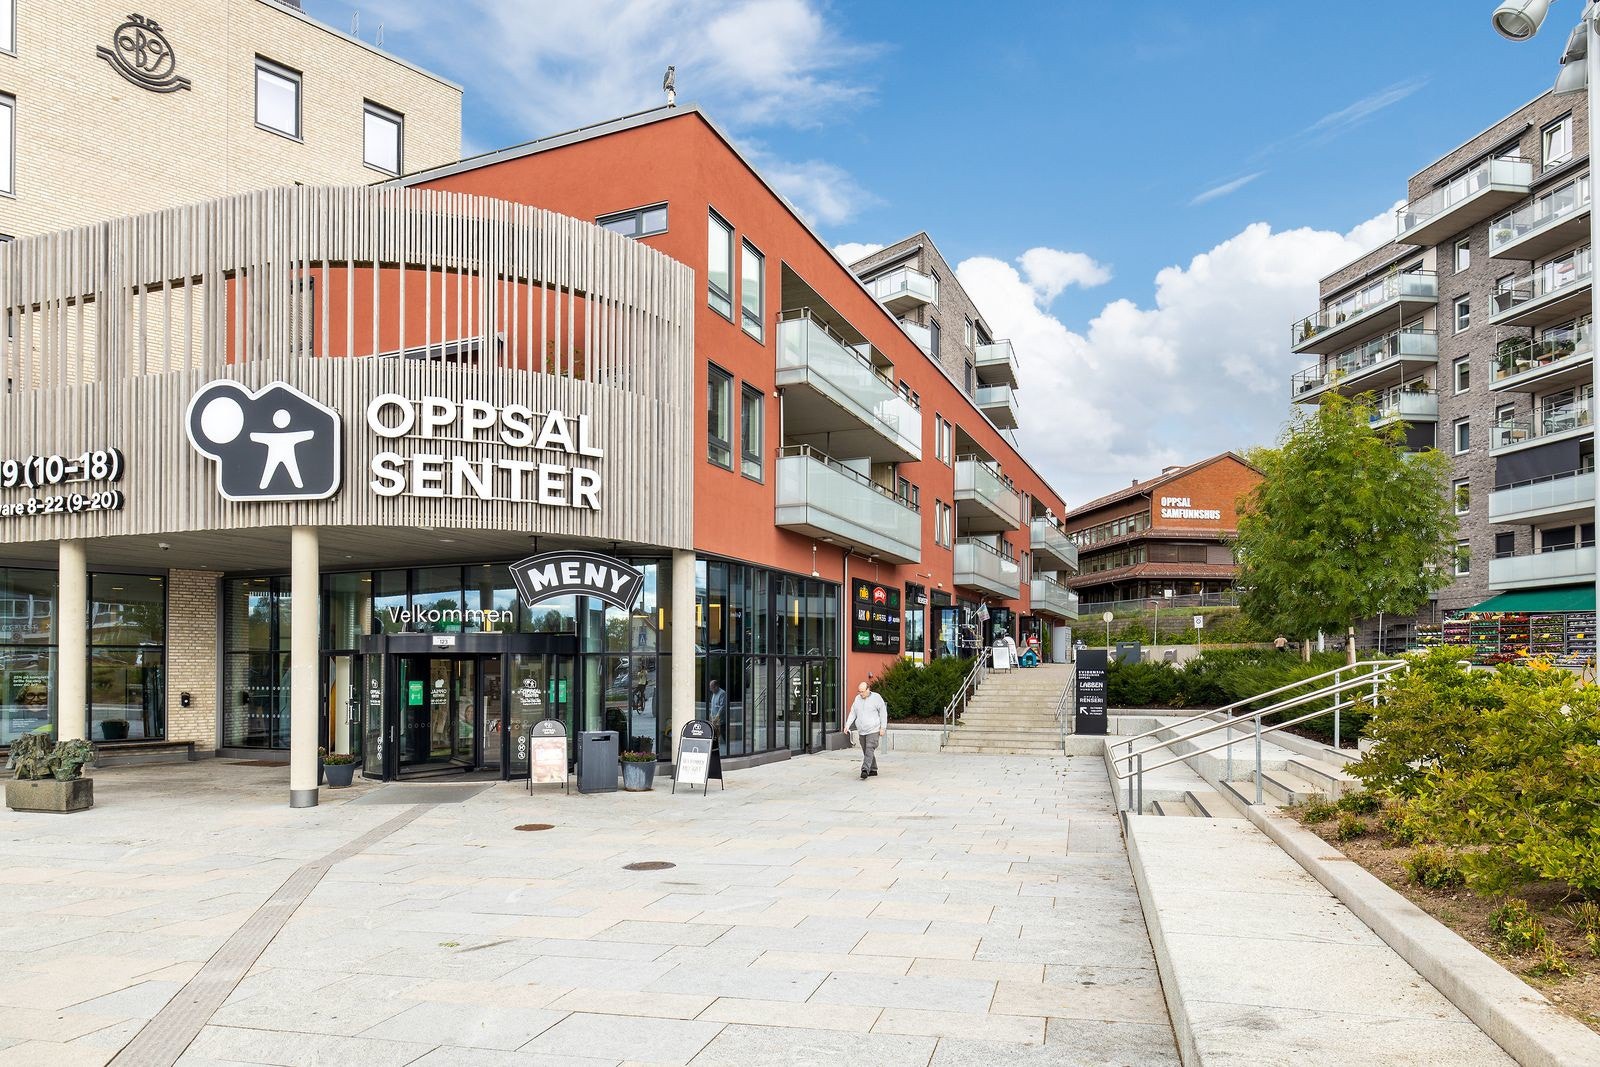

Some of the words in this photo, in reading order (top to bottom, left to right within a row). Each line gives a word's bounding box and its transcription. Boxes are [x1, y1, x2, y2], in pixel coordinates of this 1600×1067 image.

[367, 393, 604, 458] OPPSAL
[0, 459, 19, 488] 9
[370, 451, 602, 511] SENTER
[1161, 497, 1191, 508] OPPSAL
[1161, 508, 1221, 520] SAMFUNNSHUS
[527, 561, 631, 594] MENY
[388, 604, 513, 624] Velkommen
